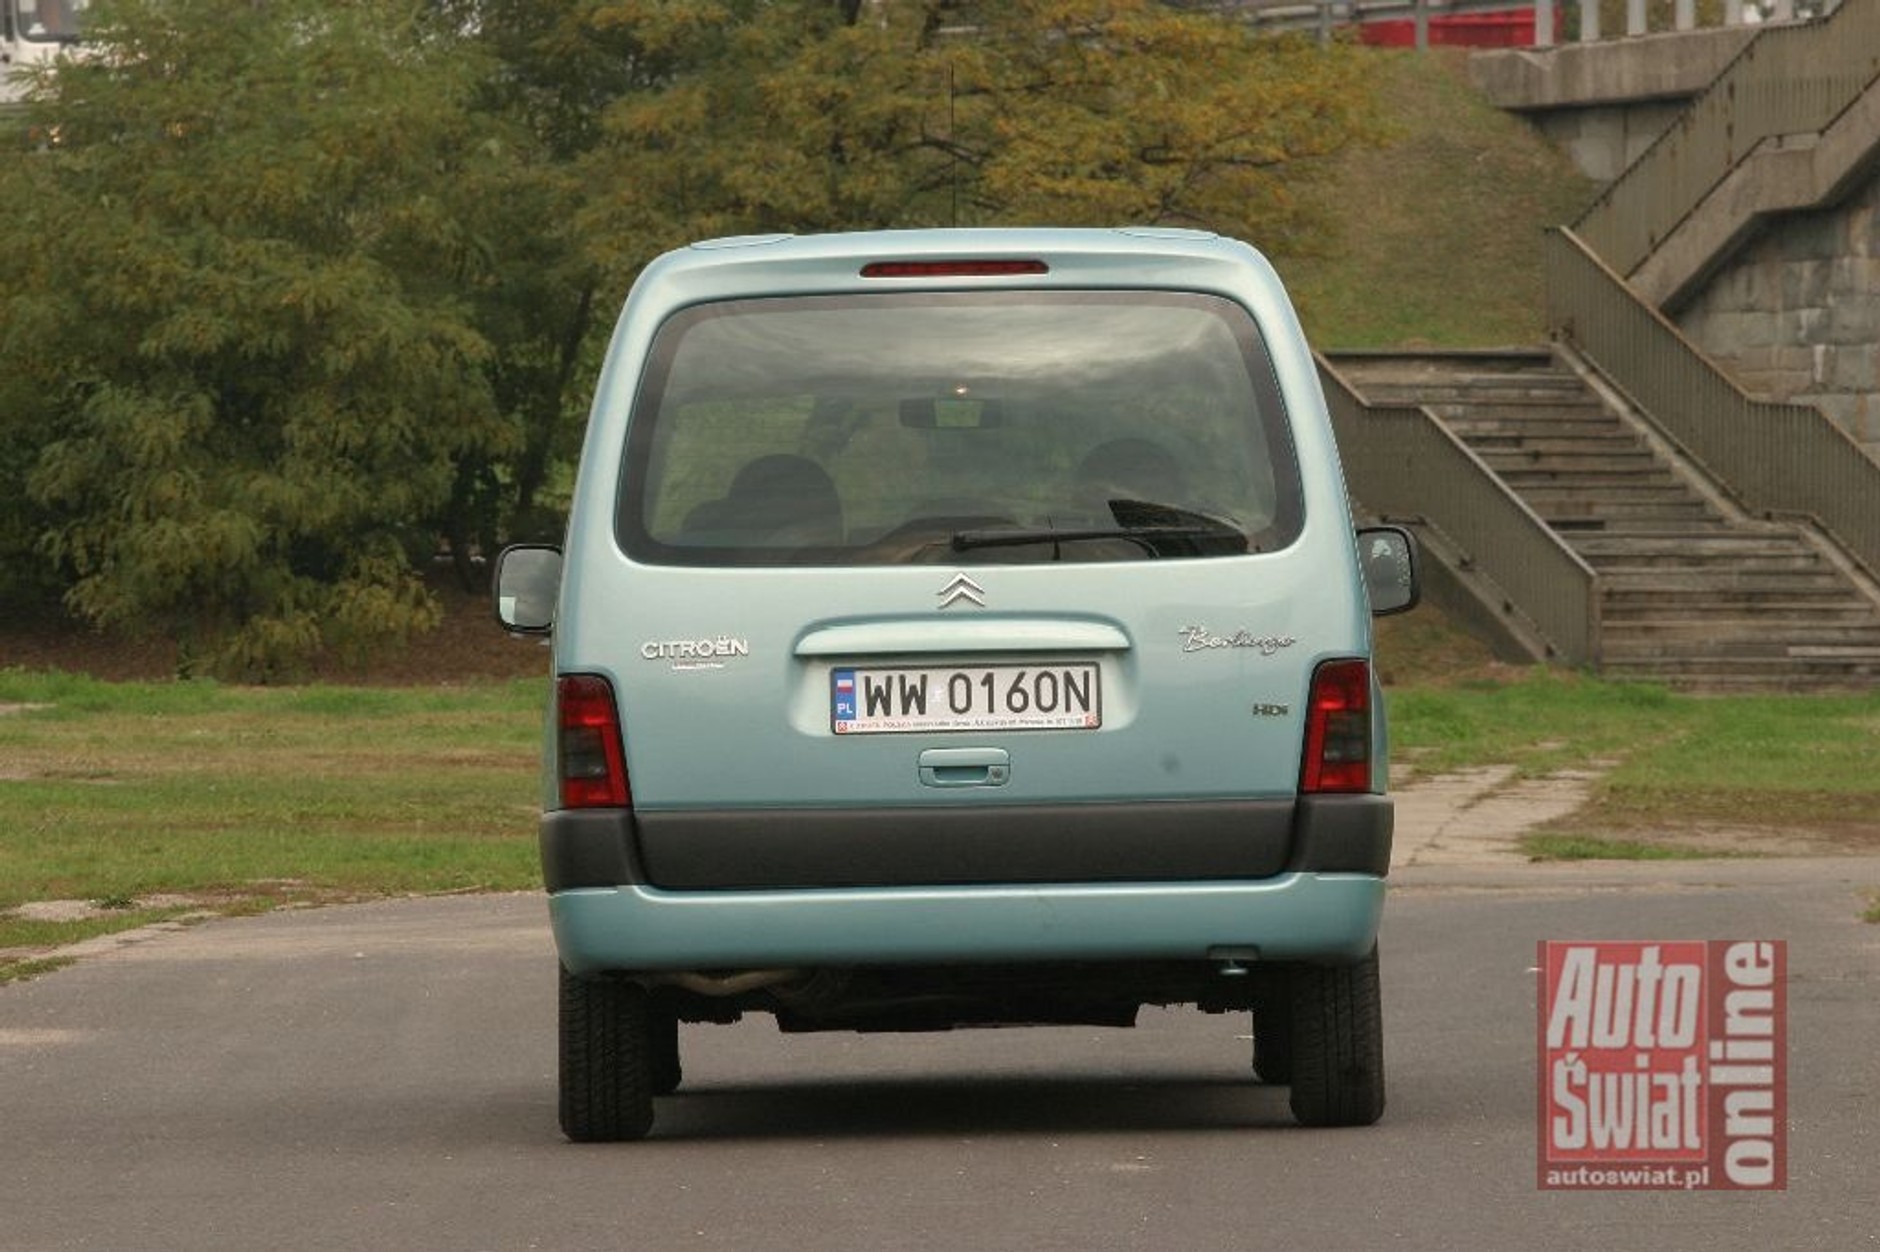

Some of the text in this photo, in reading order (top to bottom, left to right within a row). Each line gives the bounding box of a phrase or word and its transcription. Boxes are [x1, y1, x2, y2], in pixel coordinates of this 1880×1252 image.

[640, 635, 749, 660] CITROËN
[864, 670, 1090, 717] WW 0160N
[837, 703, 853, 714] PL
